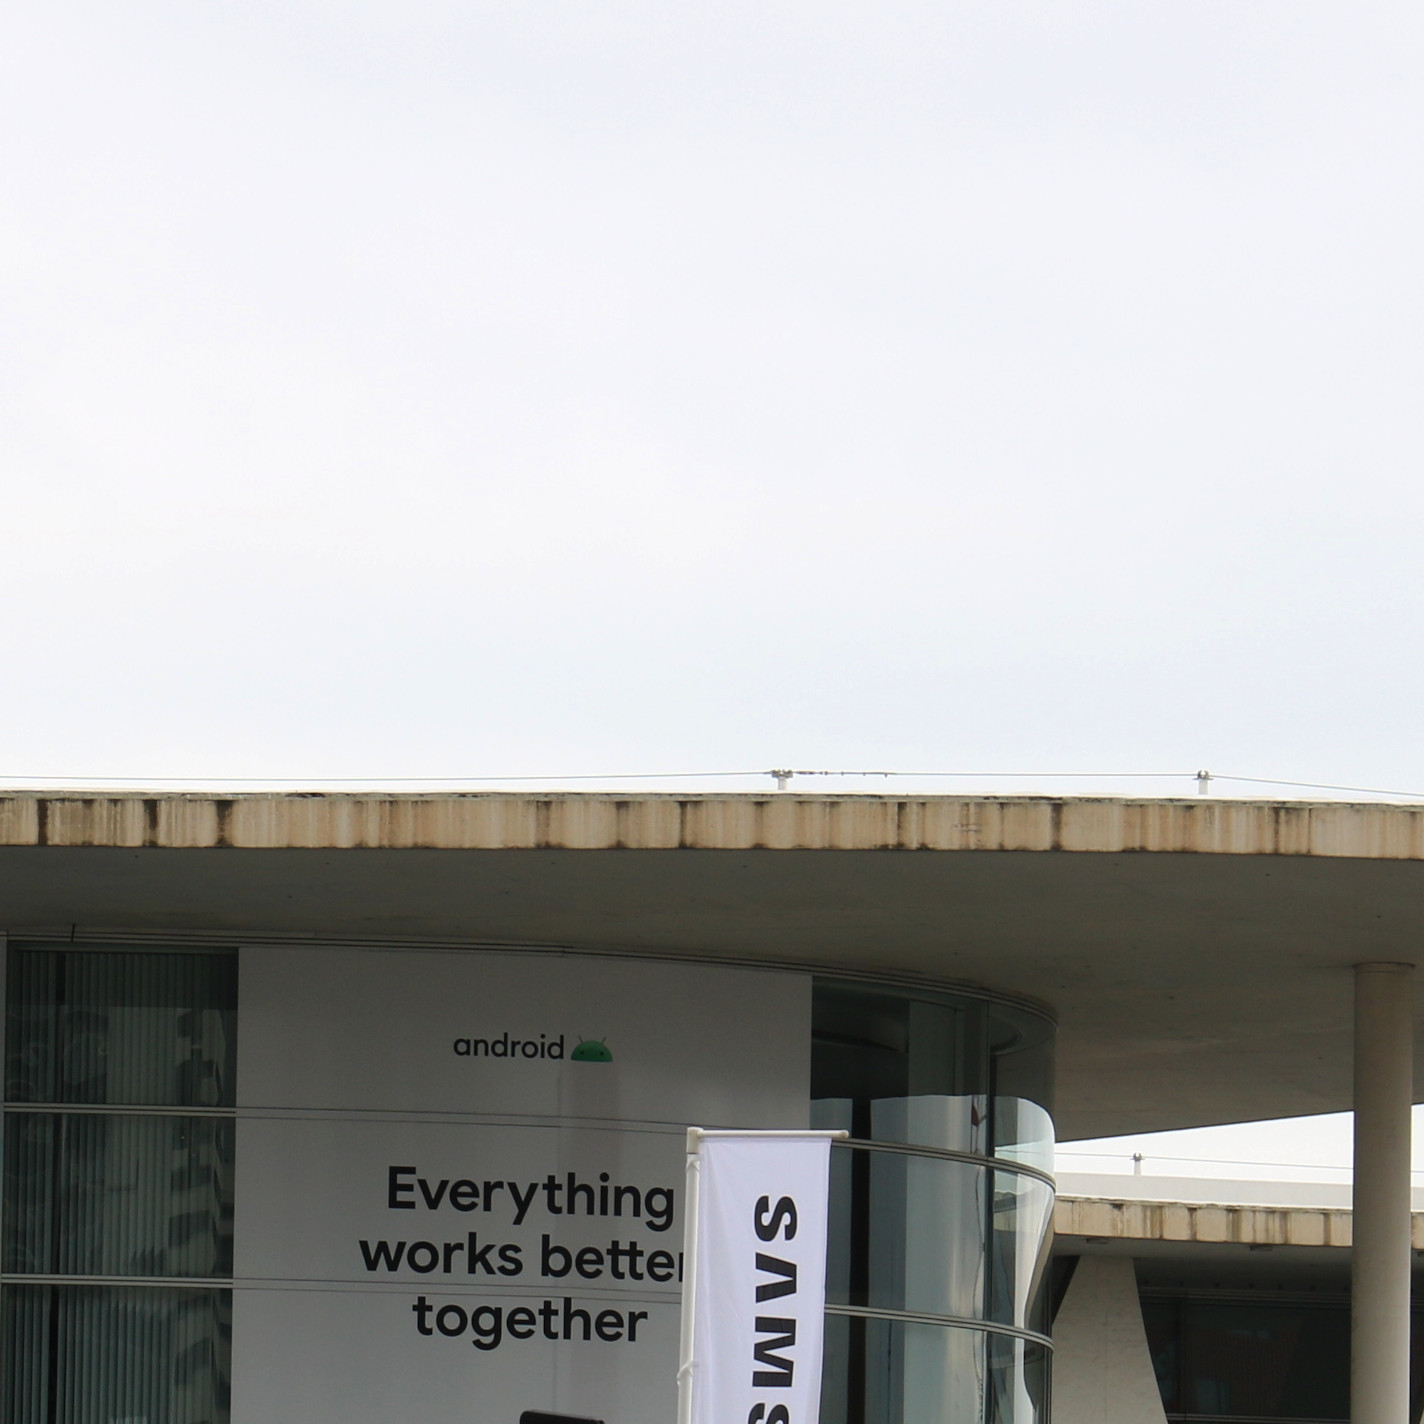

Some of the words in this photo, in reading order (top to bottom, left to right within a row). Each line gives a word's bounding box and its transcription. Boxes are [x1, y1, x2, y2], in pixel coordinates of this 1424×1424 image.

[451, 1031, 565, 1061] android
[387, 1165, 675, 1232] Everything
[358, 1231, 524, 1277] works
[412, 1296, 649, 1351] together
